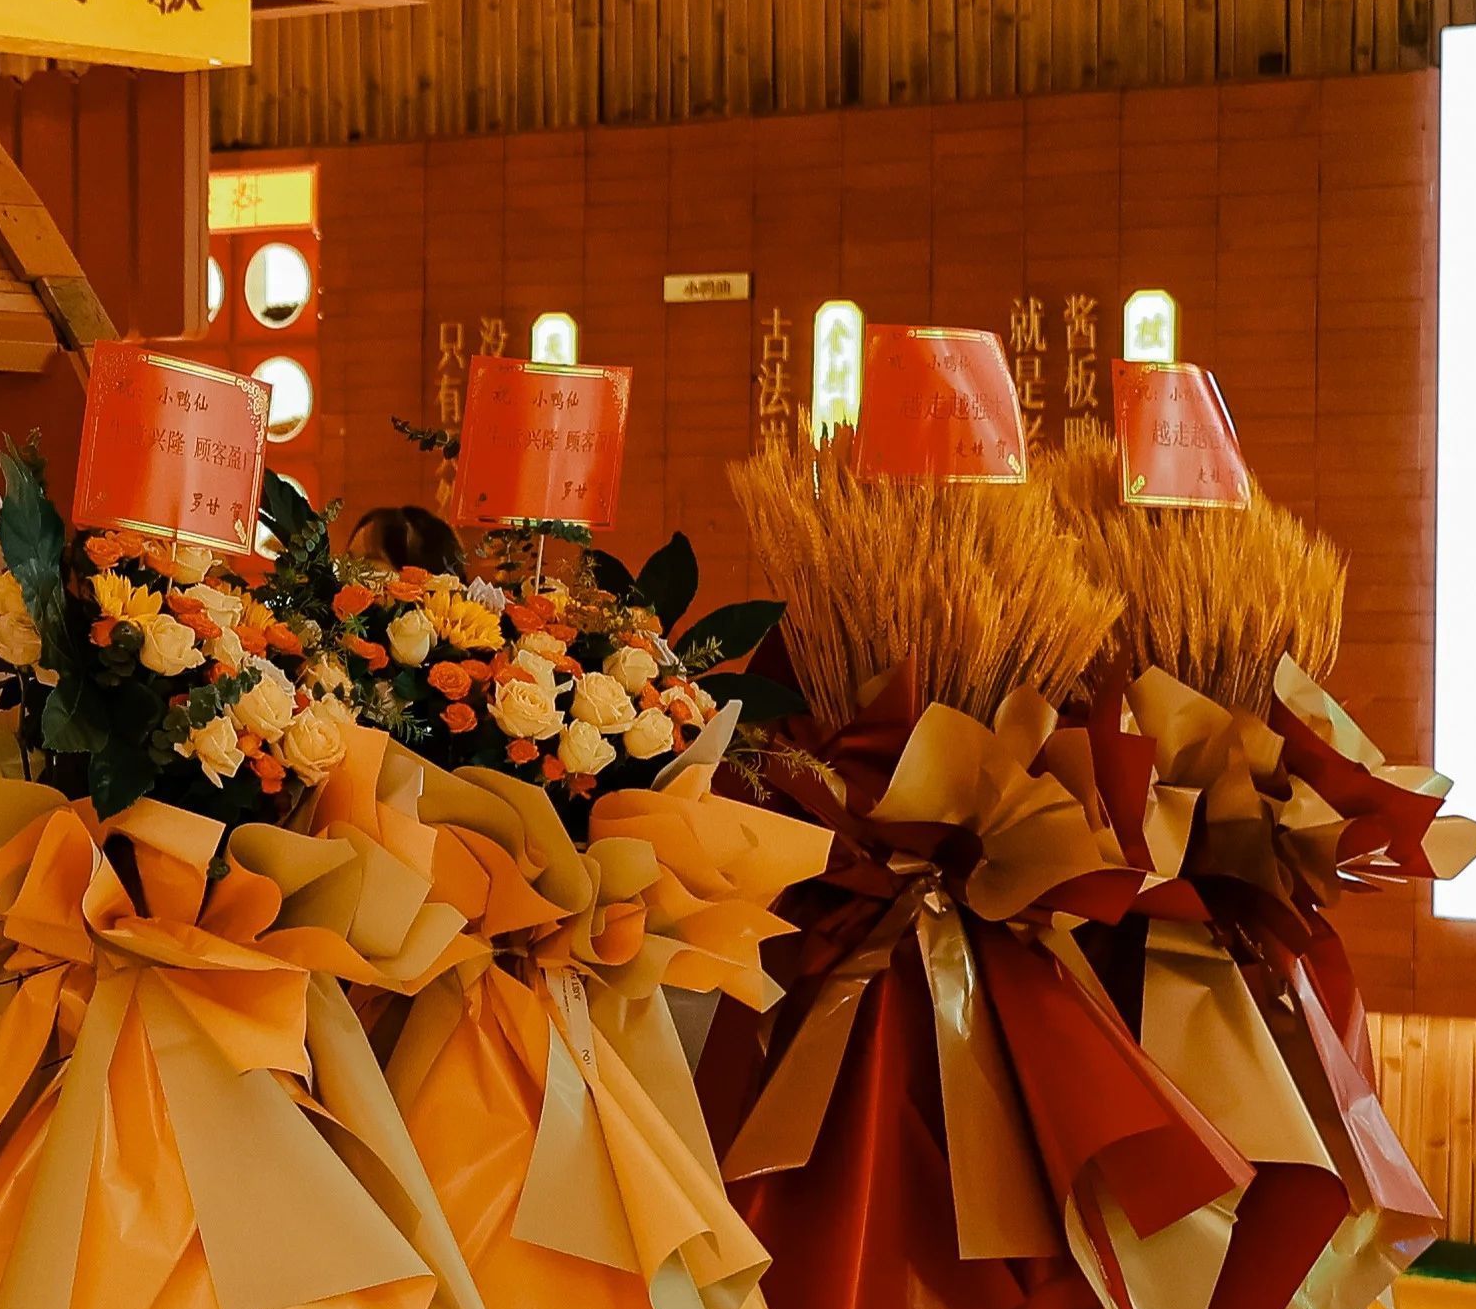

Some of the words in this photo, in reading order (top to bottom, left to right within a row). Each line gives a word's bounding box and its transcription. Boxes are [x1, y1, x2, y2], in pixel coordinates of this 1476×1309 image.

[158, 387, 209, 413] 小鸭仙
[533, 389, 580, 411] 小鸭仙
